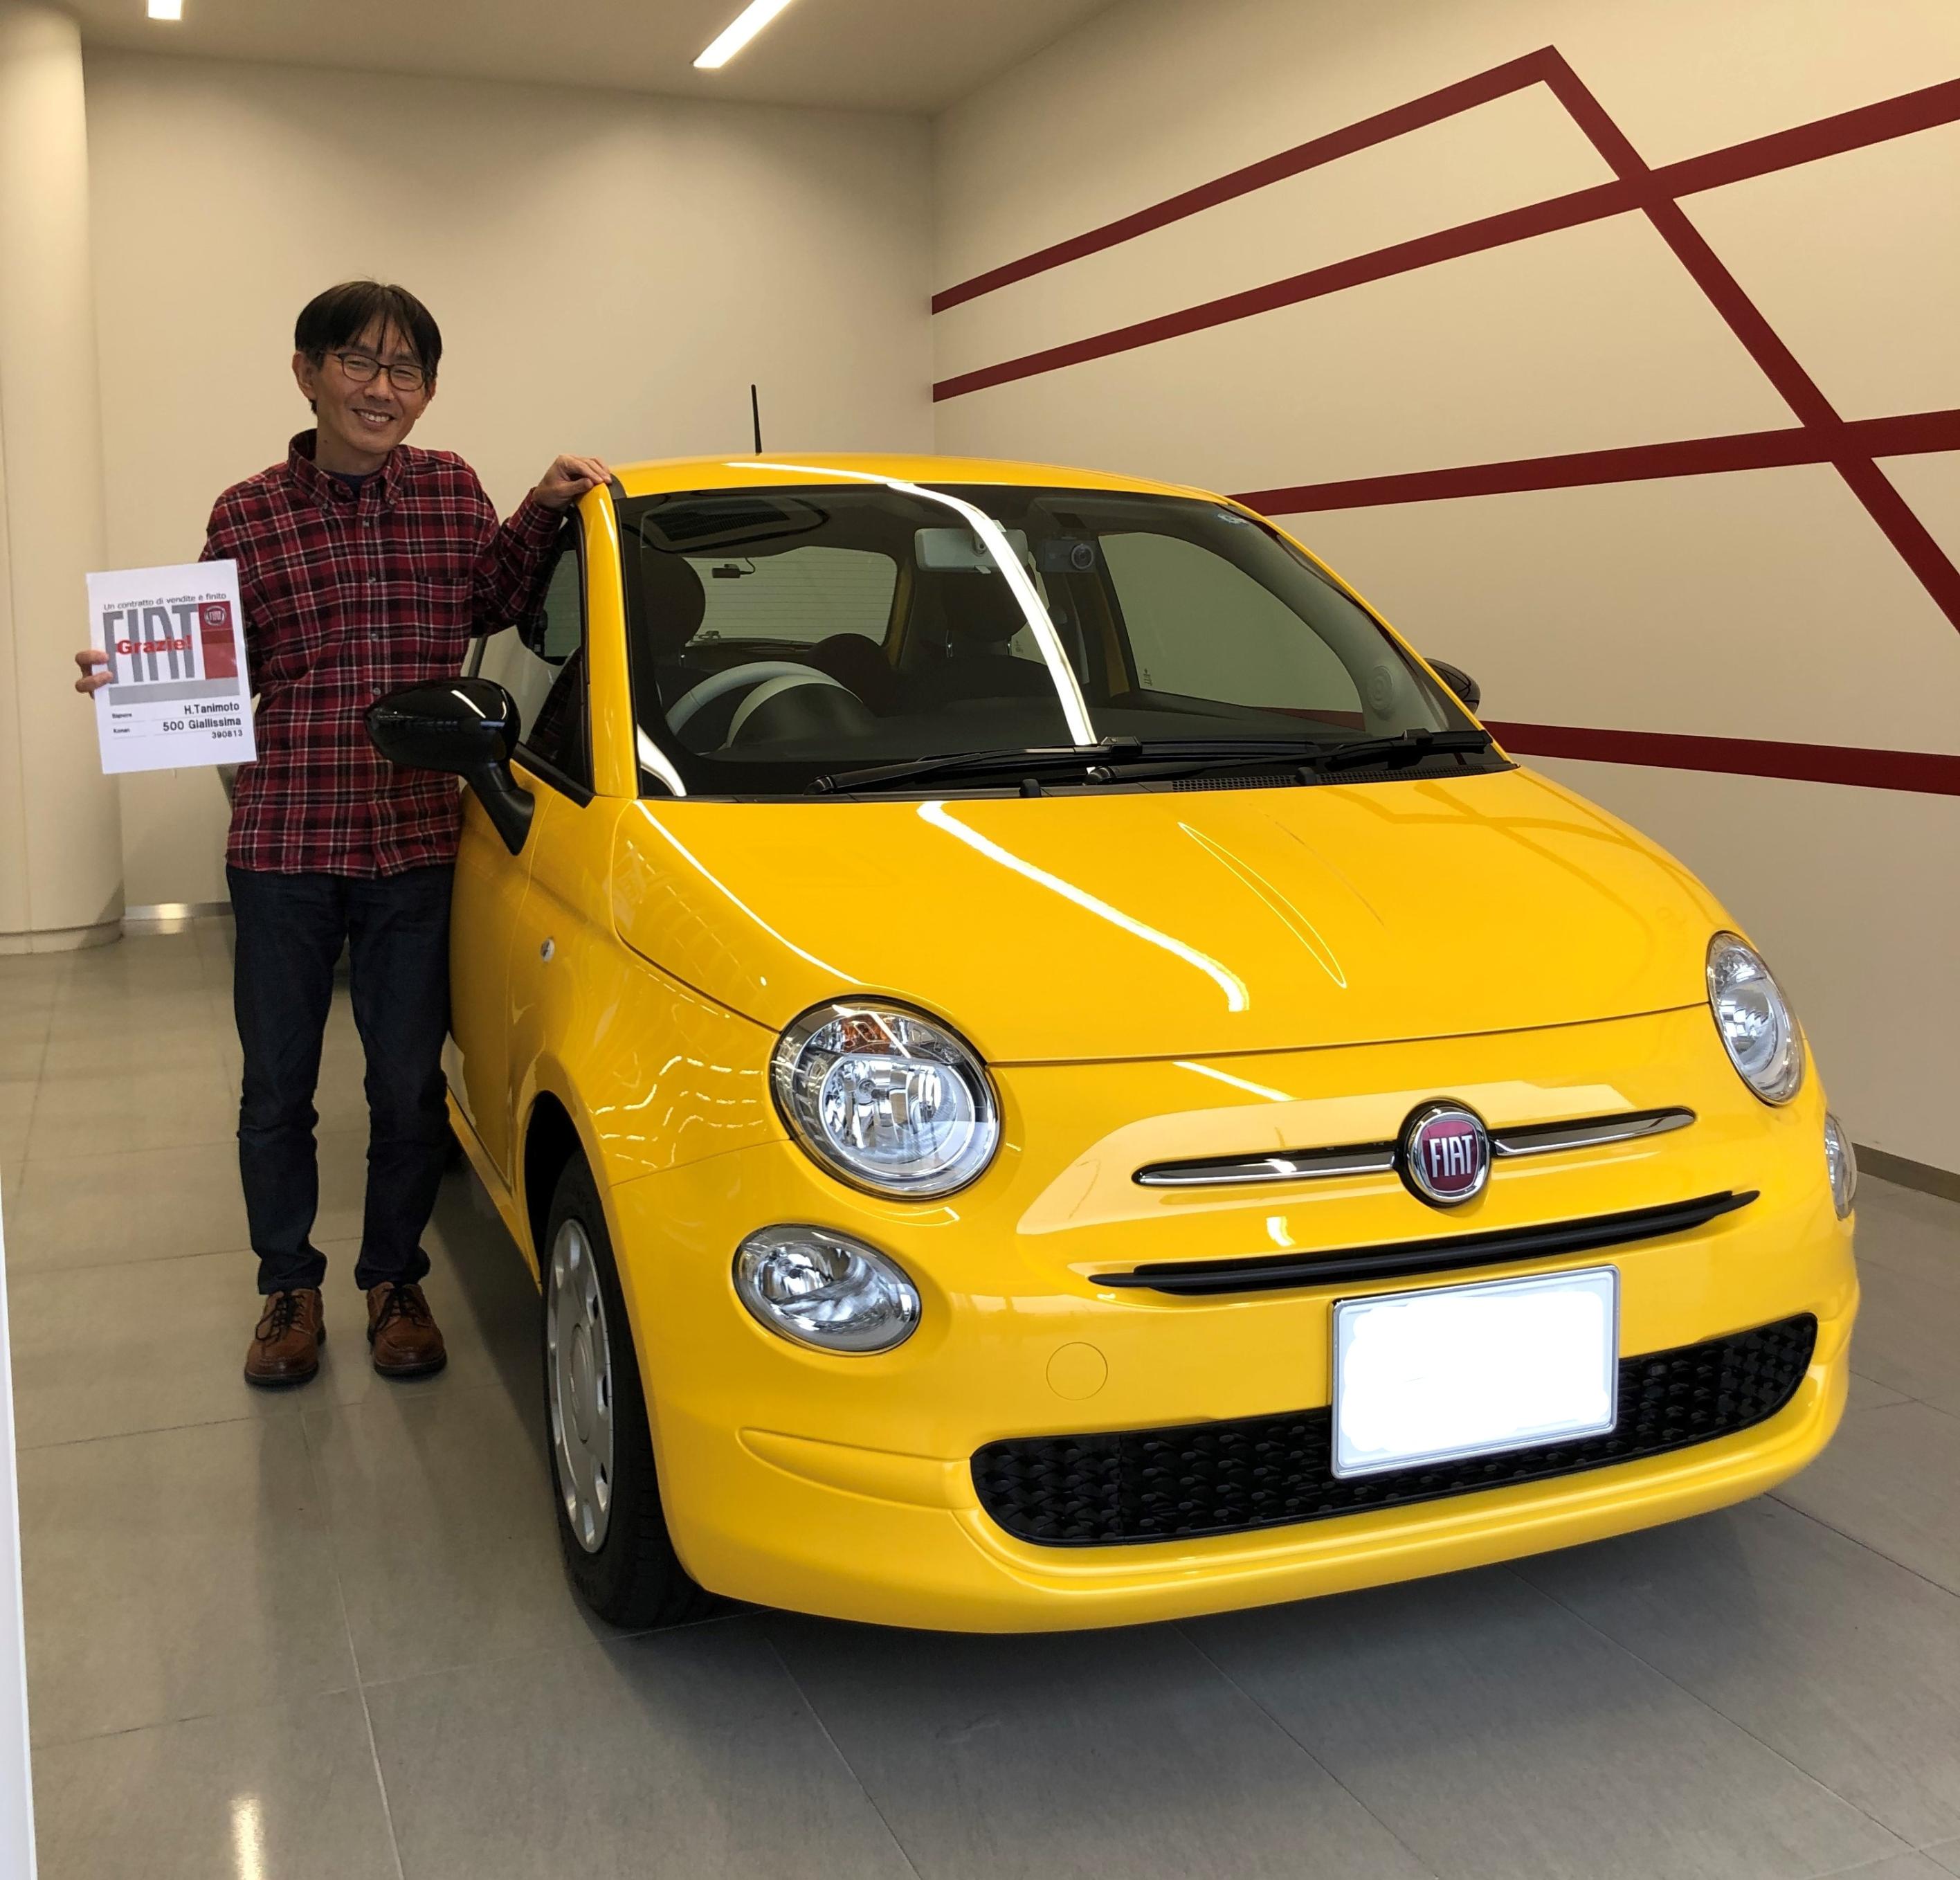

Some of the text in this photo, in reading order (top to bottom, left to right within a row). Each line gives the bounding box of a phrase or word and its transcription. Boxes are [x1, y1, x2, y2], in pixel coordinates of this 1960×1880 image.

[118, 600, 154, 609] contratto
[166, 595, 196, 604] vendite
[116, 635, 193, 654] Grazie!
[184, 702, 239, 715] H.Tanimoto
[163, 717, 242, 732] 500 Giallissima
[212, 730, 243, 739] 390813
[1429, 1135, 1473, 1177] FIAT
